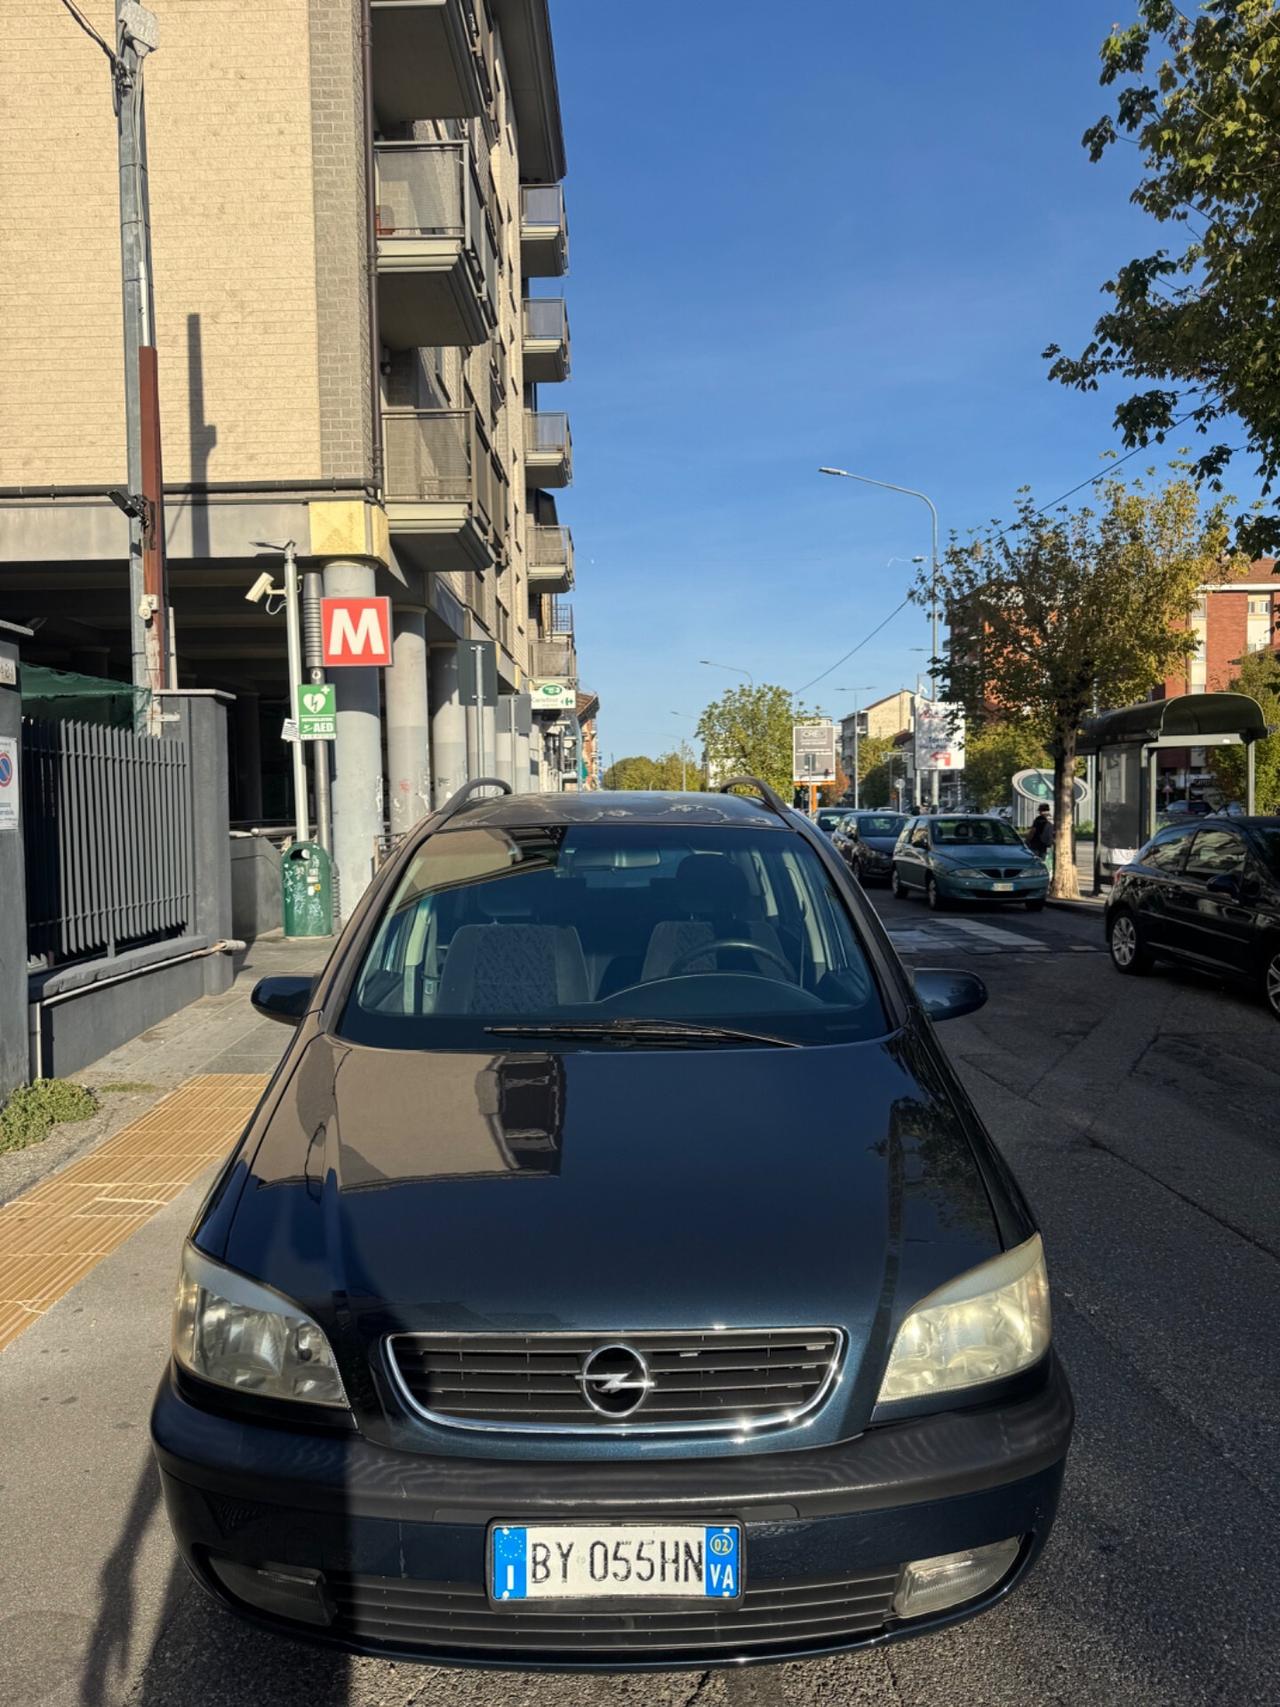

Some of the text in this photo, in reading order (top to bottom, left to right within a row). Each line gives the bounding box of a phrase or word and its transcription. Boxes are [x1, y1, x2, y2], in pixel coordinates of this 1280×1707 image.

[328, 608, 385, 655] M
[313, 722, 334, 732] AED
[713, 1539, 729, 1551] 02
[531, 1540, 703, 1583] BY 055HN
[710, 1564, 734, 1590] VA
